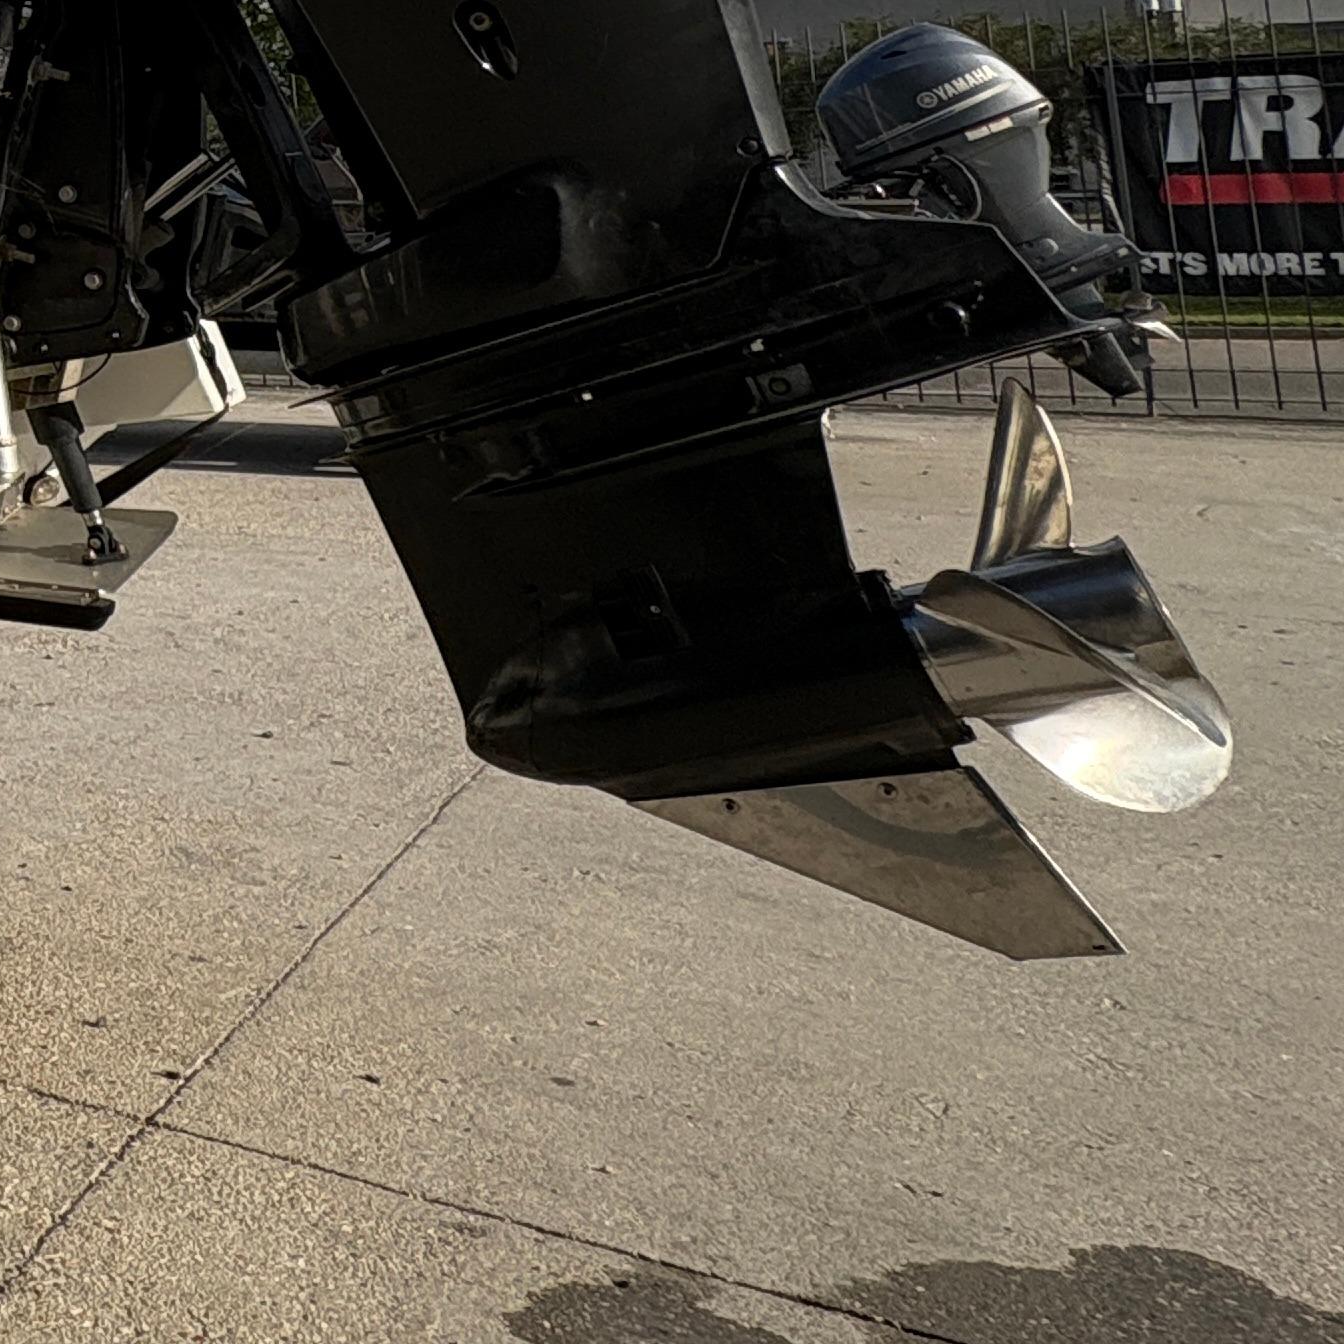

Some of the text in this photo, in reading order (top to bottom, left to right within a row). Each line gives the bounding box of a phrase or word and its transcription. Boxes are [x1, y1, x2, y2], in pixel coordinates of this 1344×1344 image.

[932, 64, 999, 101] YAMAHA
[1145, 74, 1344, 163] TR
[1217, 252, 1327, 276] MORE
